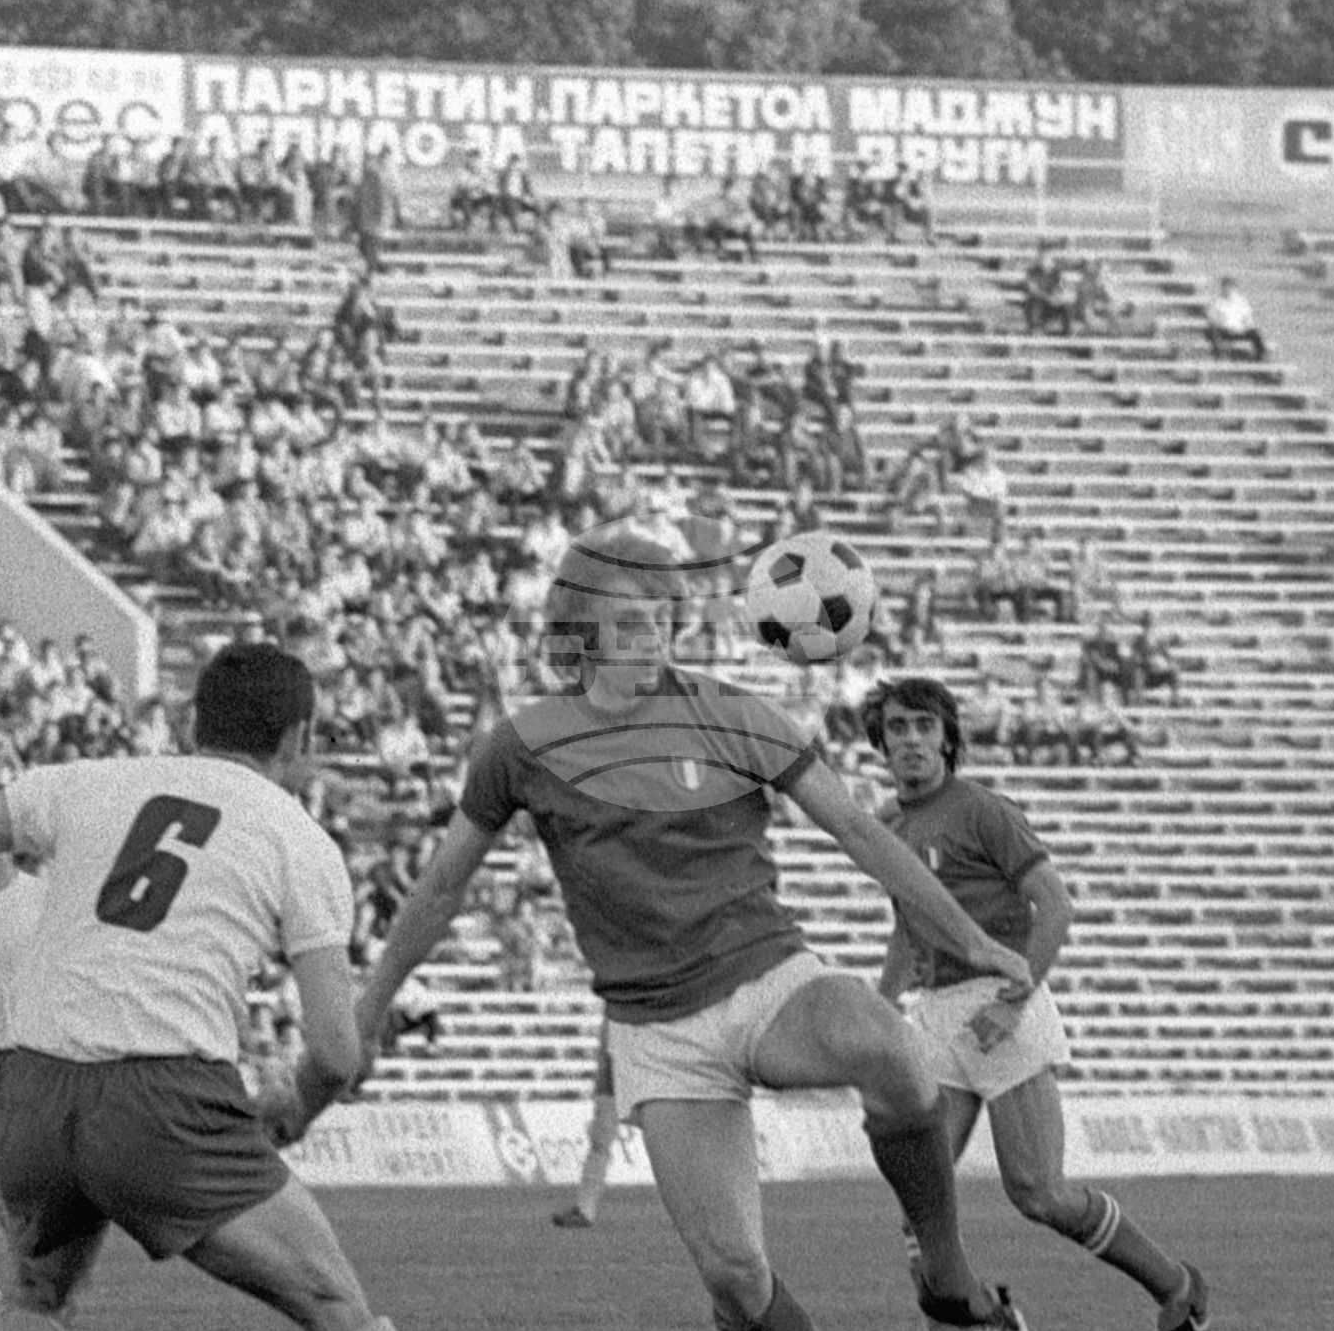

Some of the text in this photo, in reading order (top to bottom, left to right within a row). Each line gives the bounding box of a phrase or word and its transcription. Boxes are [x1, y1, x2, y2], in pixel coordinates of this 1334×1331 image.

[847, 85, 1118, 141] МАДЖУН
[461, 124, 529, 172] ЗА
[550, 127, 777, 178] ТАПЕТИ
[96, 794, 221, 933] 6
